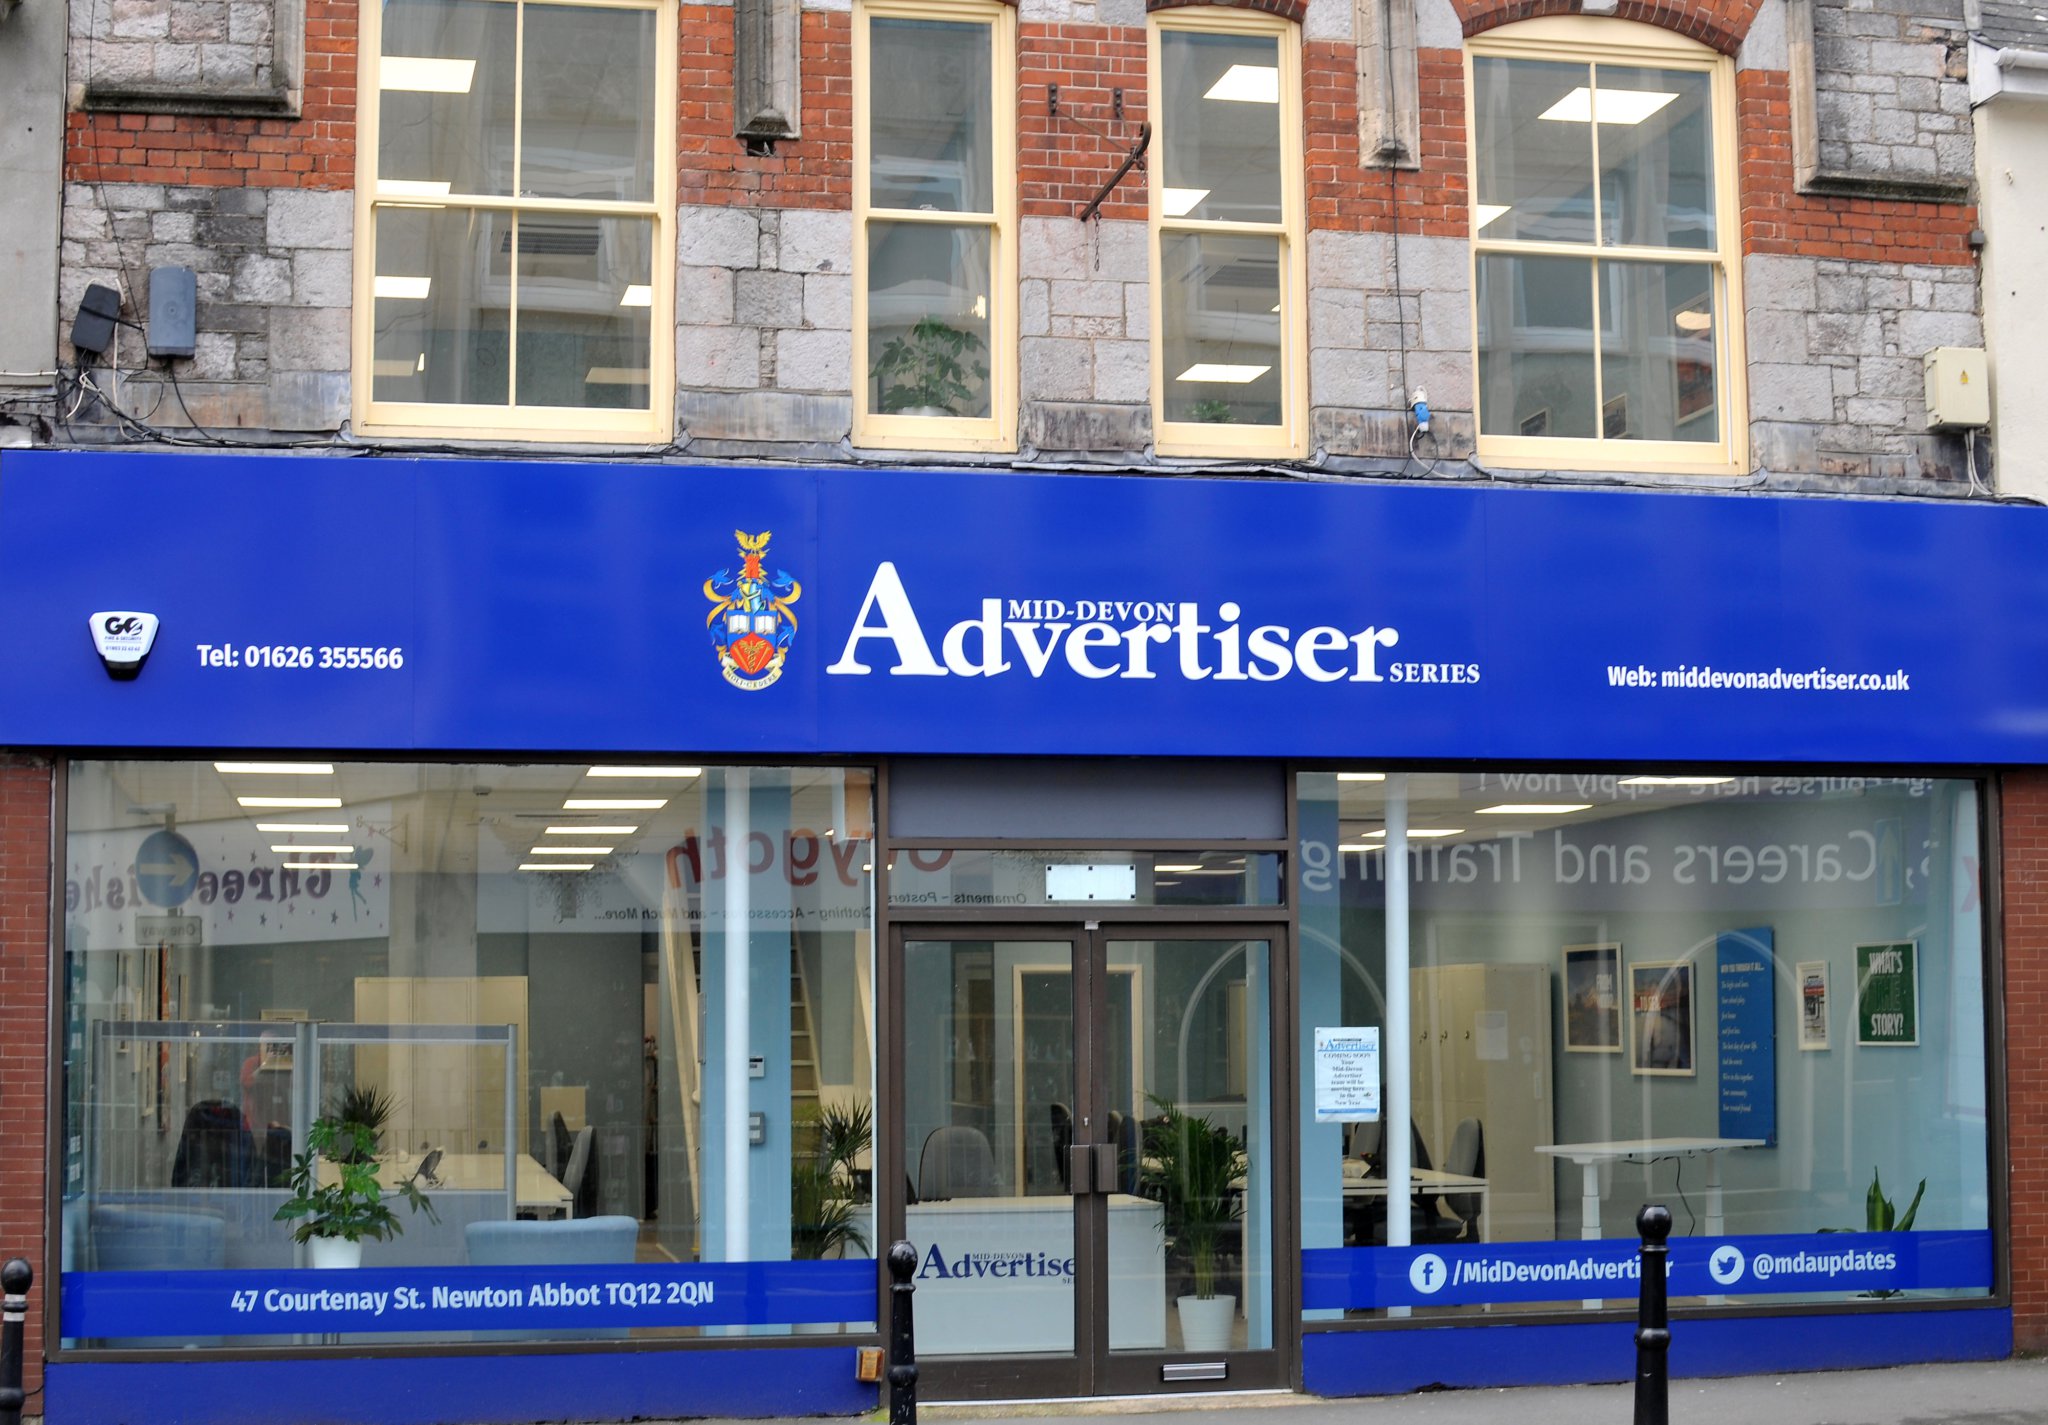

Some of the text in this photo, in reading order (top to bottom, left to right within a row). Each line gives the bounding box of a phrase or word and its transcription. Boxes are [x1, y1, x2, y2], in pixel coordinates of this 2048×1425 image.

[827, 561, 1481, 686] Advertiser SERIES
[1008, 599, 1175, 623] MID-DEVON
[196, 643, 404, 670] Tel: 01626 355566
[1607, 664, 1910, 691] Web: middevonadvertiser.co.uk
[1869, 950, 1904, 975] WHAT'S
[1871, 1013, 1904, 1037] STORY?
[972, 1252, 1025, 1260] MID-DEVON
[1752, 1250, 1896, 1280] @mdaupdates
[1452, 1257, 1673, 1286] /MidDevonAdvertir
[231, 1281, 714, 1316] 47 Courtenay St. Newton Abbot TQ12 2QN
